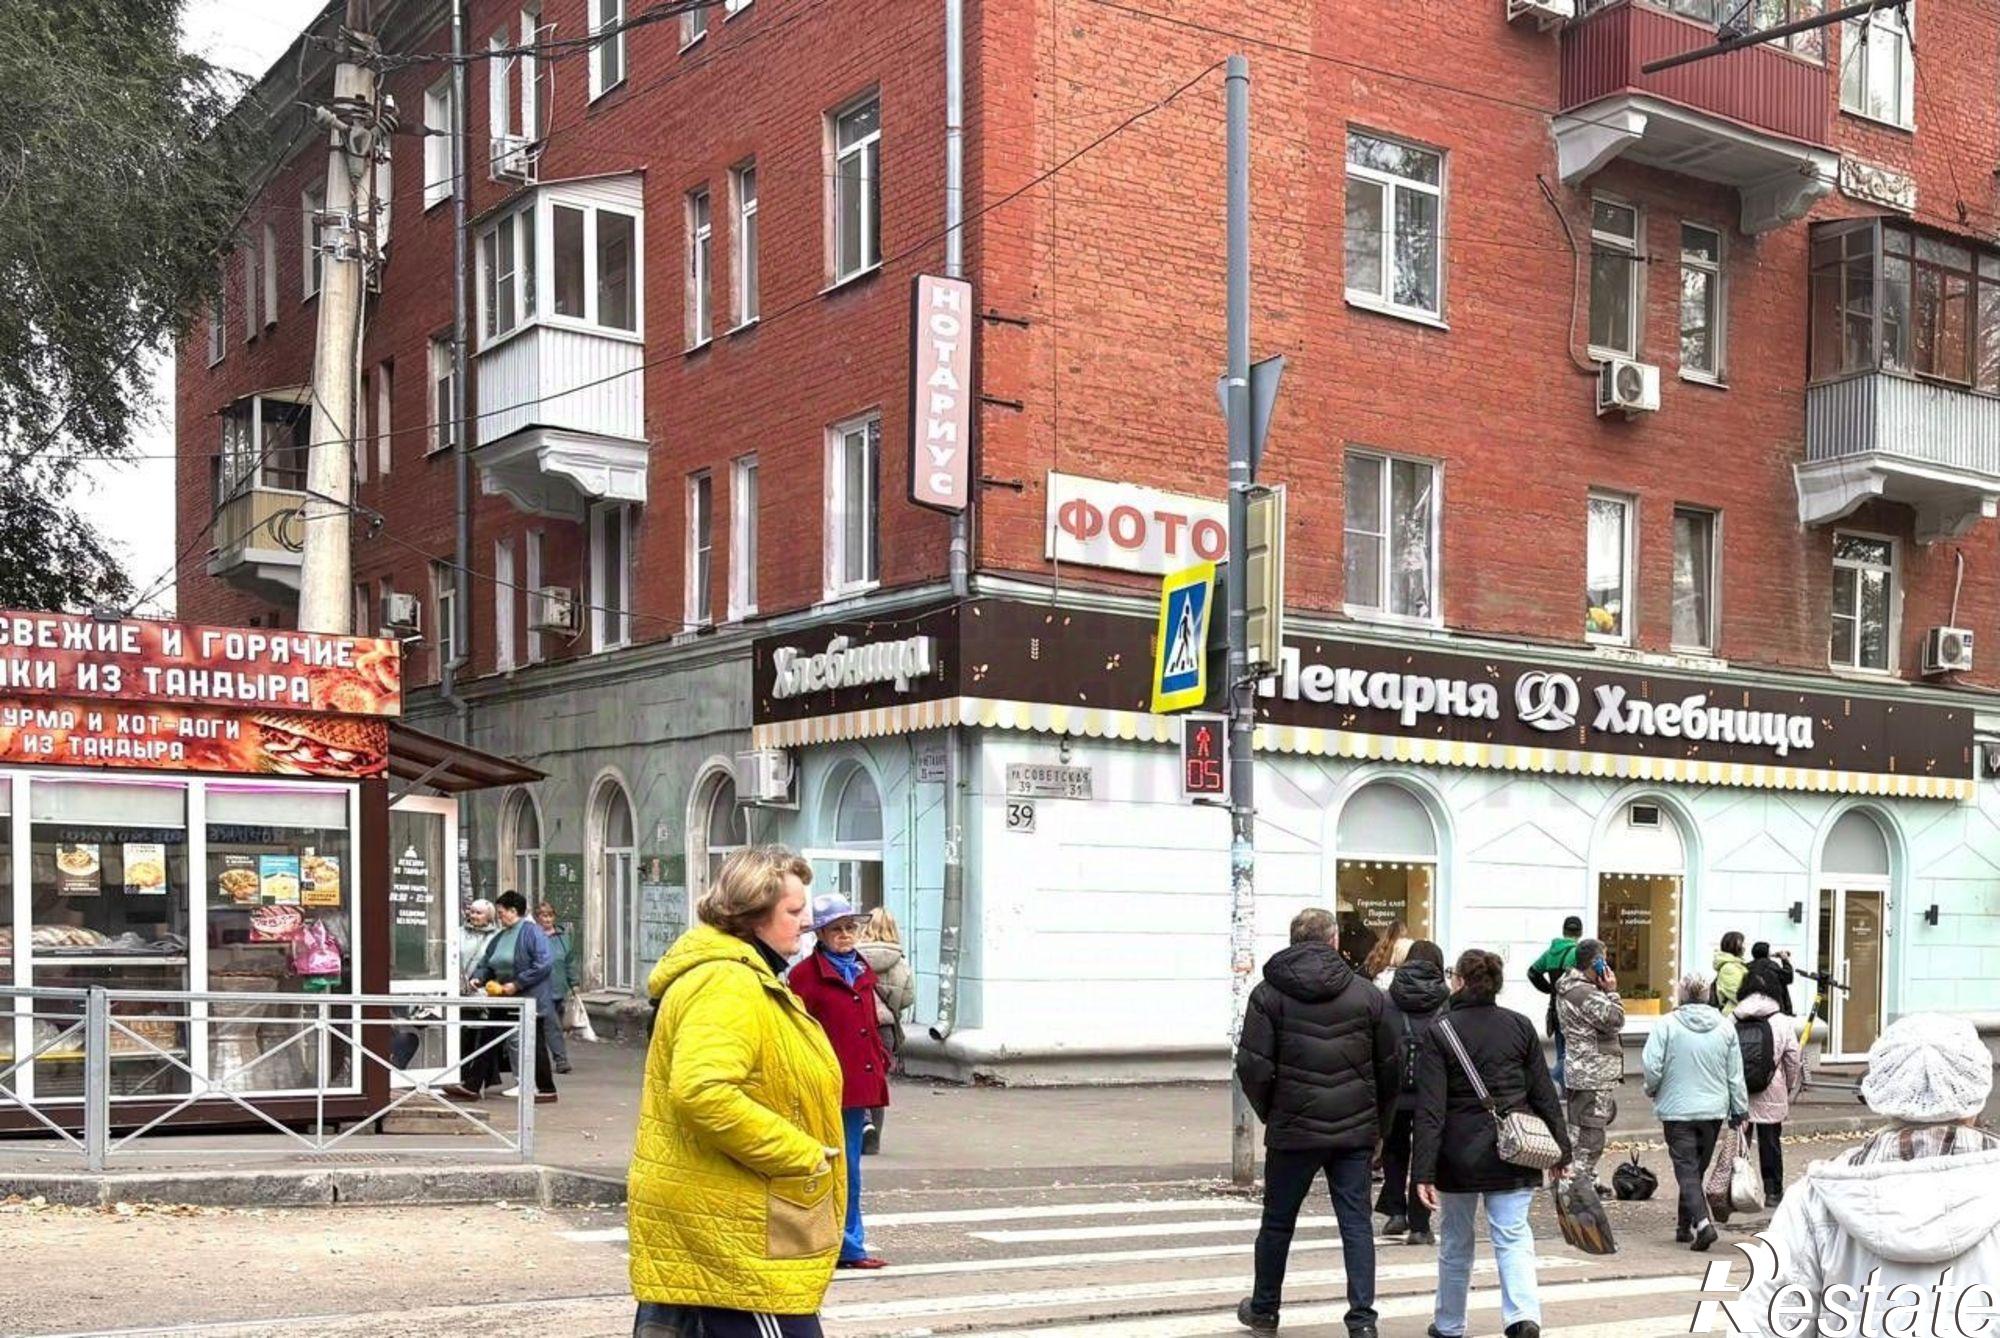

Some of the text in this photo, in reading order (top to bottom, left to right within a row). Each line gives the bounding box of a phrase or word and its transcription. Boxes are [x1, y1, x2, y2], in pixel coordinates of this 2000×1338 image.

[926, 285, 961, 497] НОТАРИУС
[1058, 498, 1228, 561] ФОТО
[161, 628, 183, 656] И
[202, 631, 355, 668] ГОРЯЧИЕ
[77, 662, 122, 692] ИЗ
[143, 666, 310, 703] ТАНДЫРА
[771, 635, 934, 699] Хлебница
[88, 711, 103, 732] И
[116, 713, 240, 739] ХОТ-ДОГИ
[1592, 684, 1815, 757] Хлебница
[23, 734, 185, 761] ИЗ ТАНДЫРА
[1018, 781, 1031, 793] 39
[1024, 768, 1089, 784] СОВЕТСКАЯ
[1187, 758, 1221, 790] 05
[1008, 804, 1034, 828] 39
